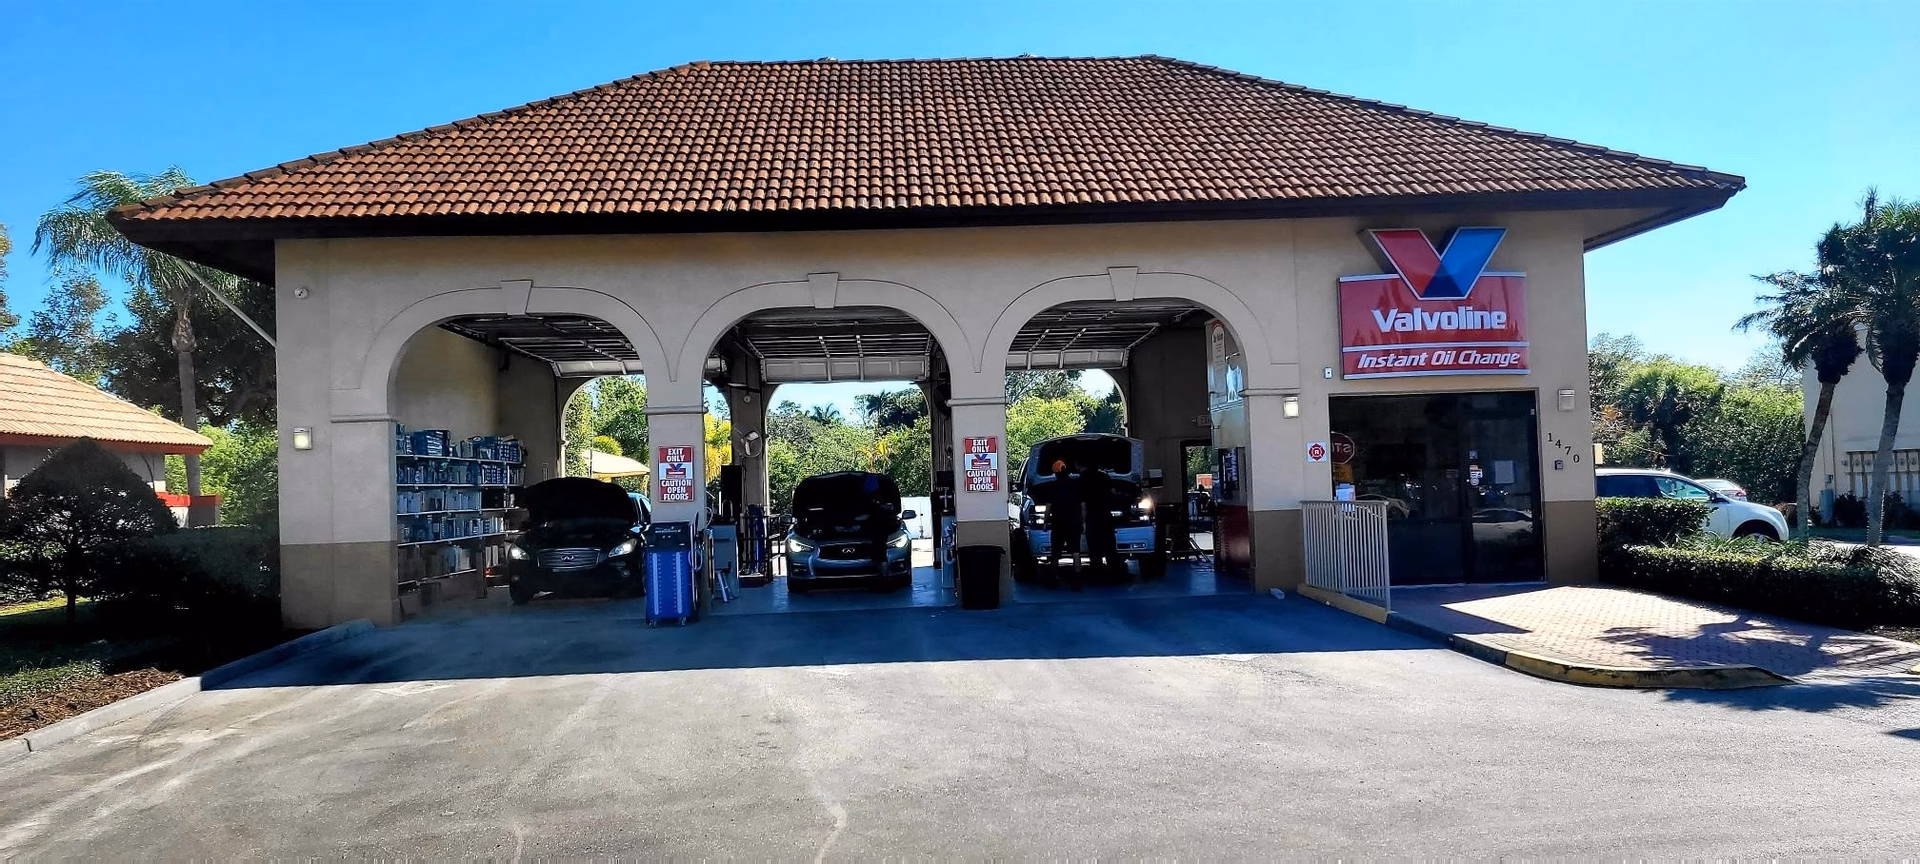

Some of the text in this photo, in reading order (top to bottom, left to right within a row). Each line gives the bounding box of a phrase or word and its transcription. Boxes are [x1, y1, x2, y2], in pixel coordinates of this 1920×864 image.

[1371, 306, 1507, 333] Valvoline
[1358, 350, 1520, 368] Instant Oil Change
[1547, 432, 1580, 463] 1470
